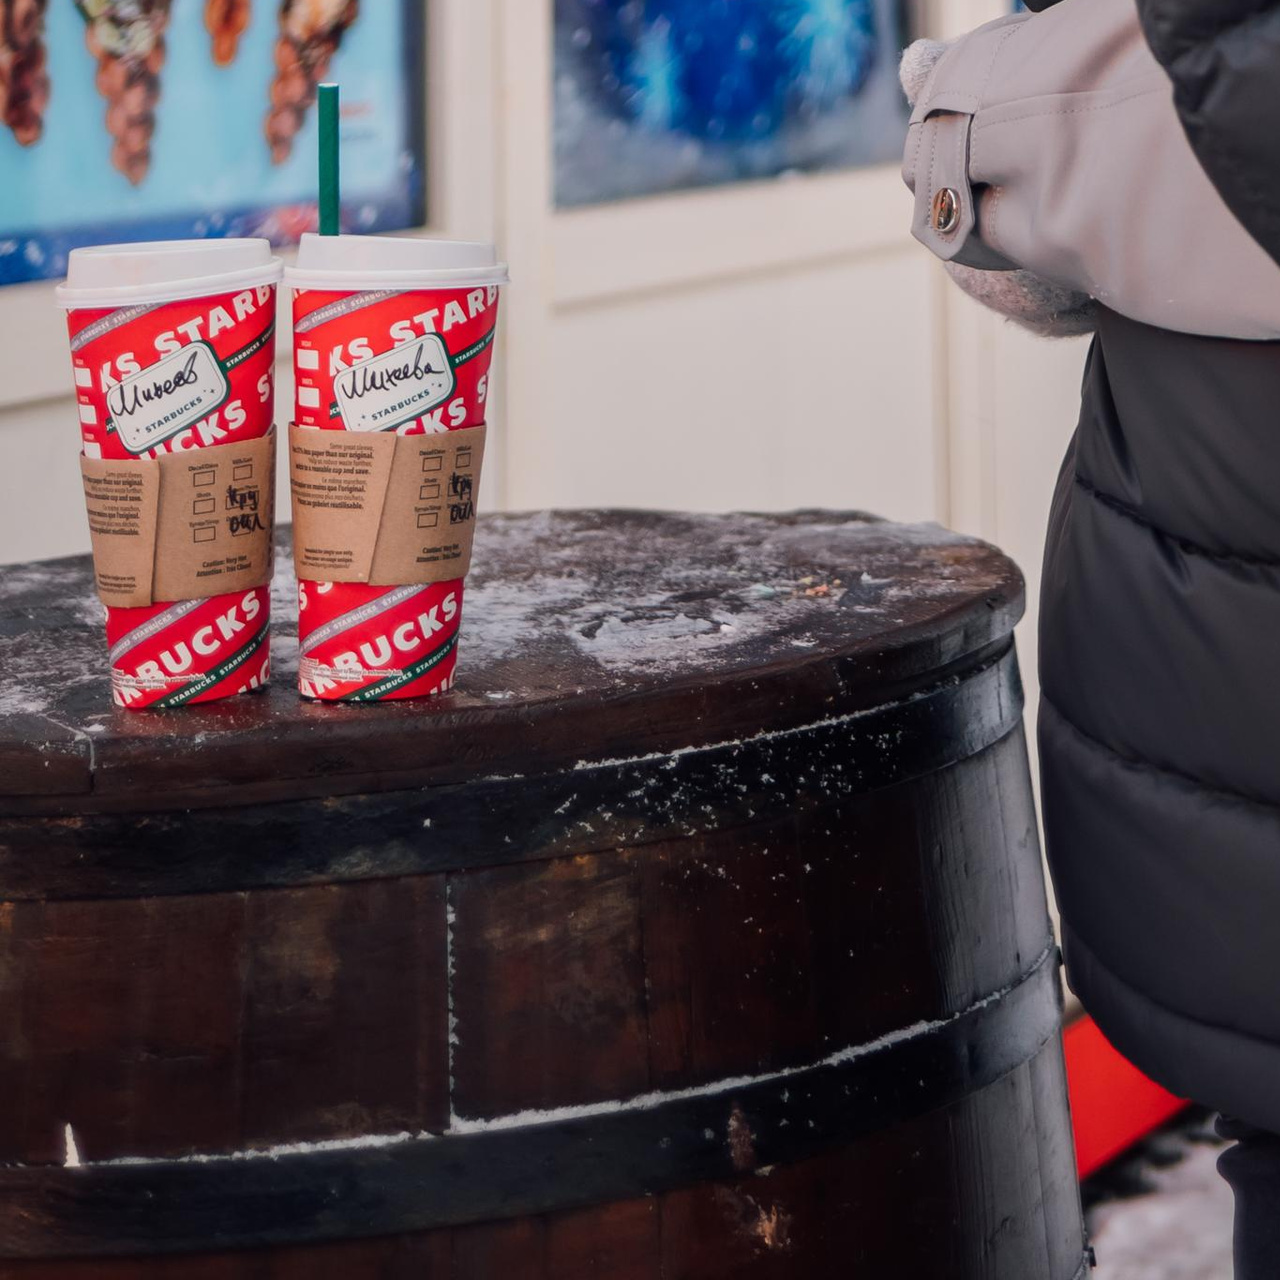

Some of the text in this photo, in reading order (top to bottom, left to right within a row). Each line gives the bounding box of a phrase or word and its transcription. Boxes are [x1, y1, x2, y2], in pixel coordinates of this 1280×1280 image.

[154, 286, 275, 361] STARB
[145, 396, 203, 434] STARBUCKS
[371, 389, 430, 421] STARBUCKS
[343, 466, 355, 475] and
[355, 468, 372, 476] save.
[349, 450, 374, 460] original.
[333, 604, 377, 630] STARBUCKS
[169, 674, 217, 705] STARBUCKS
[219, 643, 256, 676] STARBUCKS
[364, 644, 451, 699] STARBUCKS STARBUCKS
